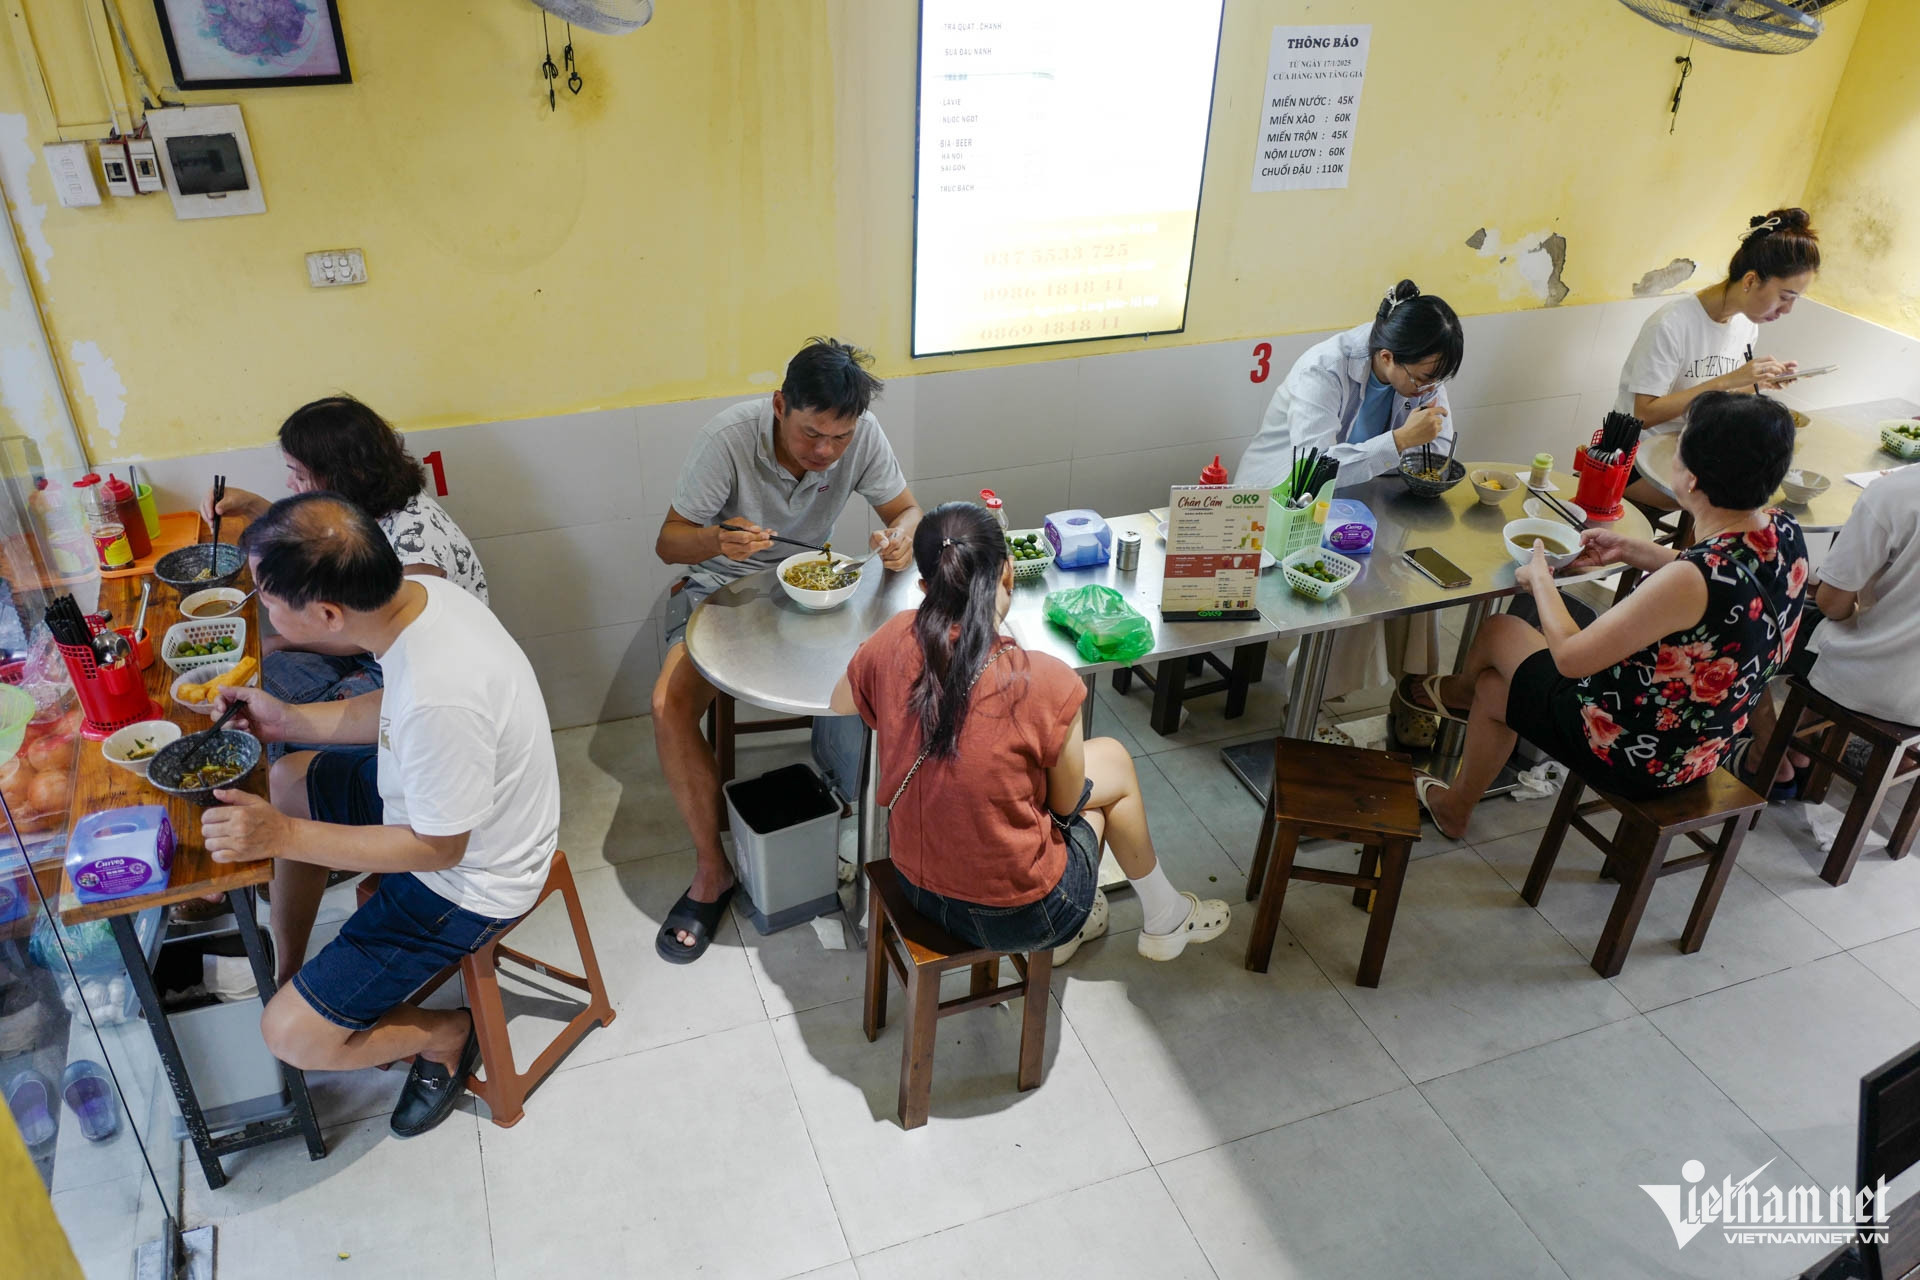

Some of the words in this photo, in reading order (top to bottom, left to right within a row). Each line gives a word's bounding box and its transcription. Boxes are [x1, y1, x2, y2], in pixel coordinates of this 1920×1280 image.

[1287, 35, 1331, 49] THÔNG
[1333, 34, 1359, 48] BÁO
[1314, 71, 1327, 79] XIN
[1271, 94, 1296, 107] MIẾN
[1299, 94, 1327, 107] NƯỚC
[1337, 95, 1354, 105] 45K
[1269, 112, 1294, 125] MIẾN
[1296, 113, 1316, 124] XÀO
[1334, 113, 1351, 123] 60K
[955, 138, 973, 147] BEER
[1267, 130, 1291, 142] MIẾN
[1293, 130, 1318, 143] TRỘN
[1331, 130, 1348, 139] 45K
[1264, 148, 1288, 160] NỘM
[1289, 148, 1316, 159] LƯƠN
[1328, 147, 1346, 156] 60K
[1261, 163, 1291, 176] CHUỐI
[1292, 163, 1312, 176] ĐẬU
[1321, 164, 1344, 173] 110K
[1093, 242, 1129, 259] 725
[979, 323, 1033, 340] 0869
[1250, 342, 1272, 384] 3
[423, 451, 448, 496] 1
[1232, 494, 1260, 504] OK9
